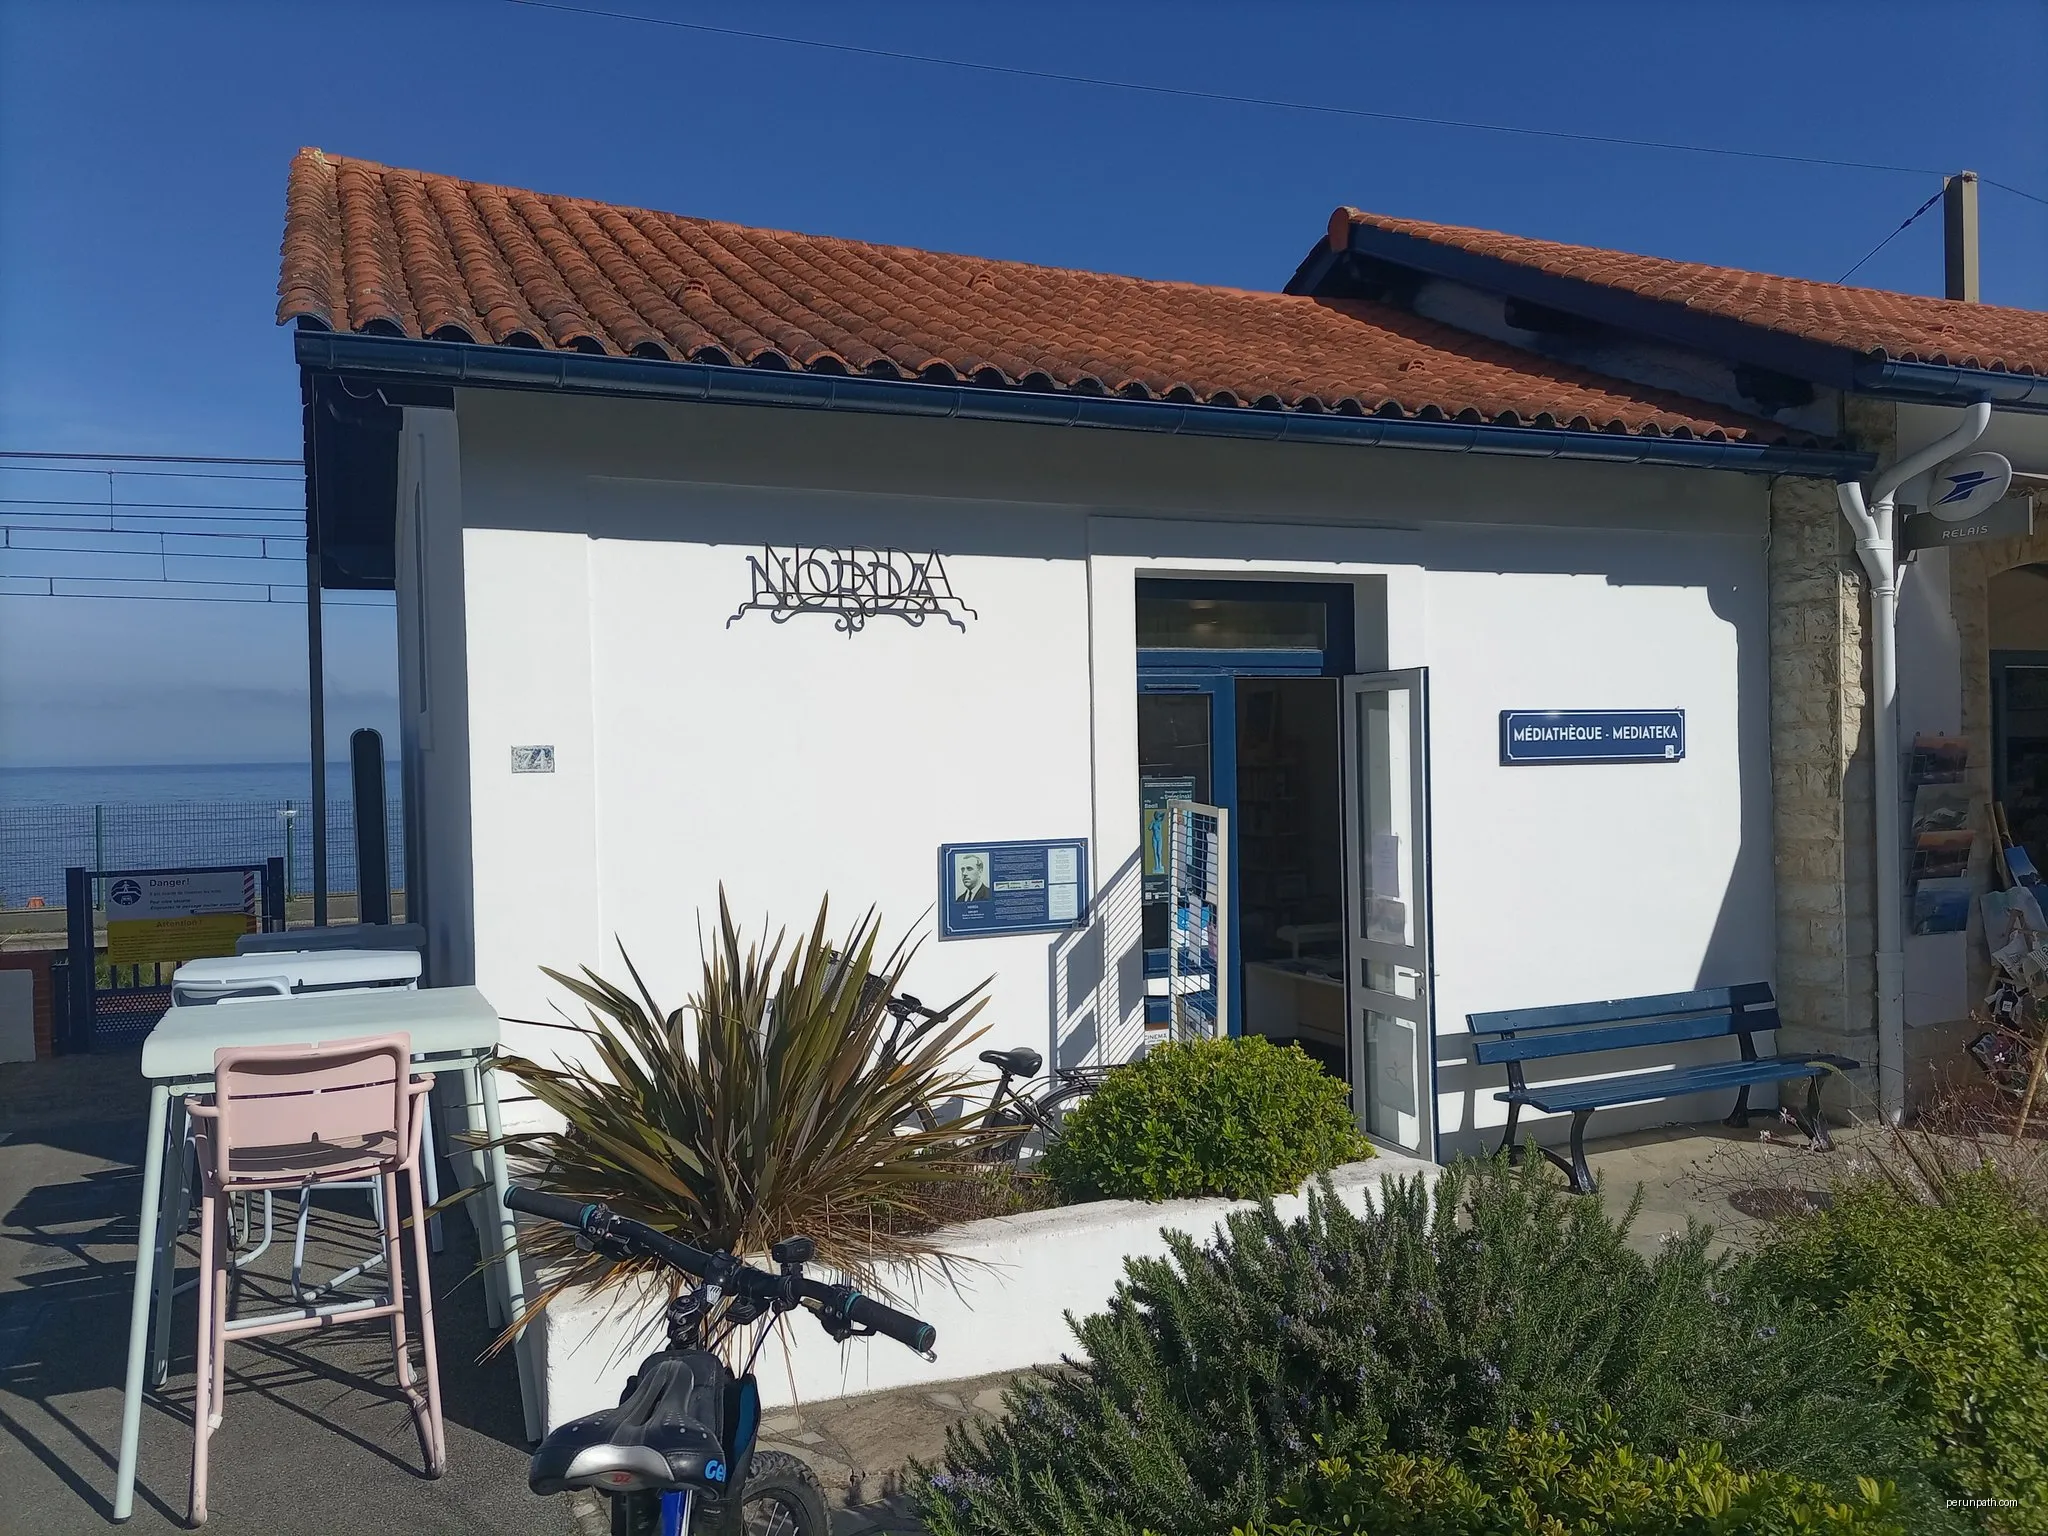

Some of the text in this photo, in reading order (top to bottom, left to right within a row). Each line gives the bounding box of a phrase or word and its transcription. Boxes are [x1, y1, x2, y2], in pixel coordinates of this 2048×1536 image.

[1942, 525, 1989, 540] RELAIS
[764, 542, 955, 598] NORDA
[1513, 724, 1602, 741] MÉDIATHÈQUE
[1612, 725, 1678, 740] MEDIATEKA
[149, 878, 190, 888] Danger!
[156, 920, 197, 928] Attention
